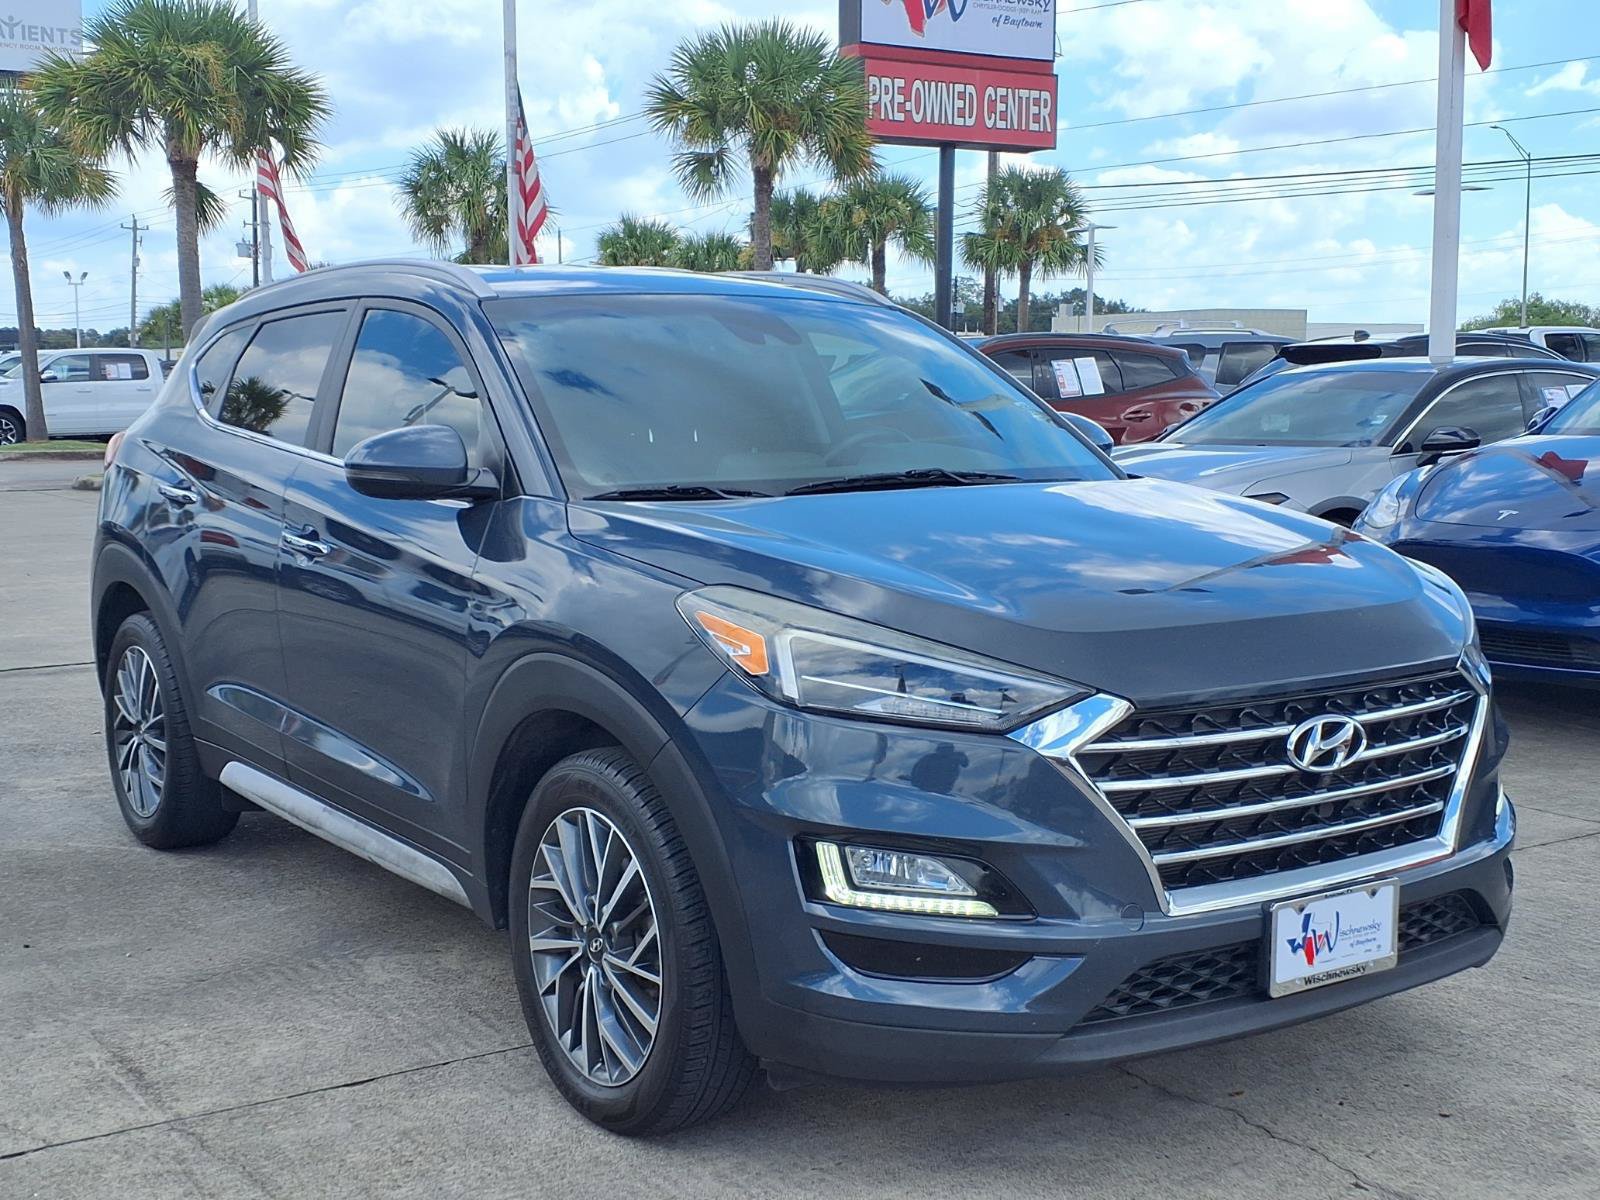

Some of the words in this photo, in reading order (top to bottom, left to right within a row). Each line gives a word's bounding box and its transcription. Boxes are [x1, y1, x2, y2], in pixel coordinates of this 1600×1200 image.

[1003, 15, 1043, 29] Baytown
[868, 75, 977, 127] PRE-OWNED
[983, 86, 1052, 133] CENTER
[1303, 963, 1367, 986] Wischnewsky
